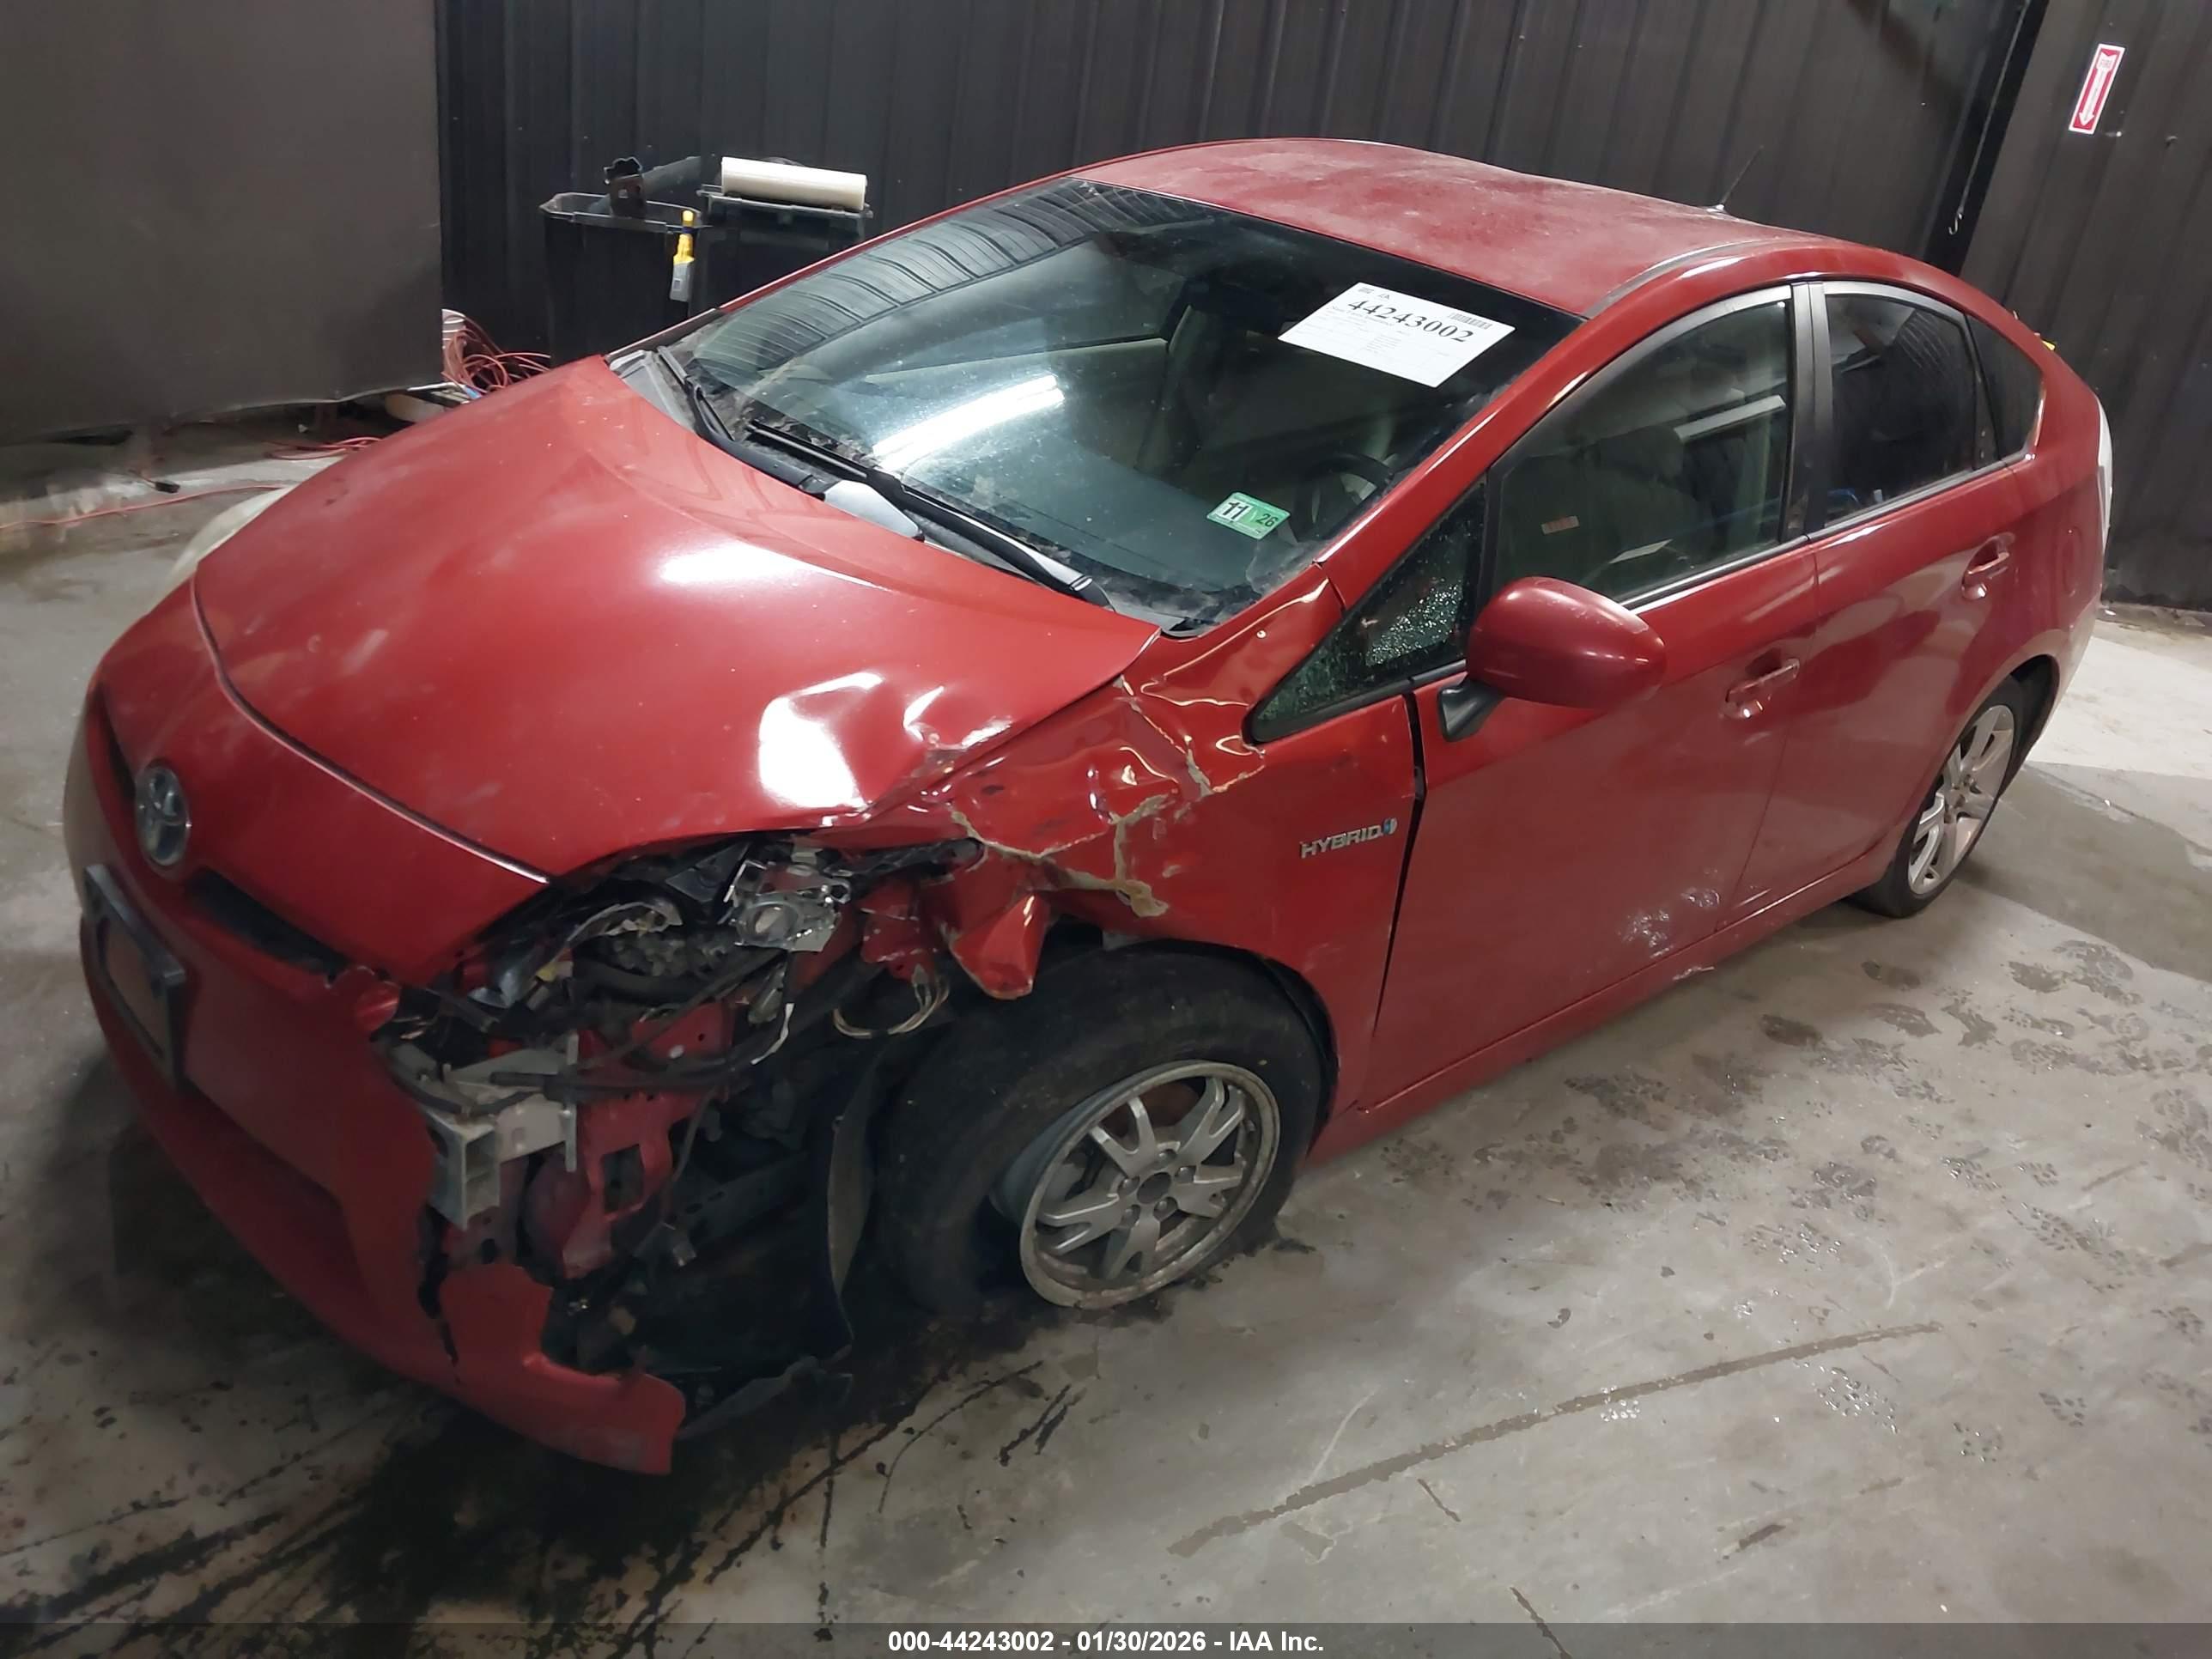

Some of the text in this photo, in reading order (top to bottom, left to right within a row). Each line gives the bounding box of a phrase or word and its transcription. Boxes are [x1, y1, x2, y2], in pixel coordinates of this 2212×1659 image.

[1347, 300, 1474, 343] 44243002
[1222, 501, 1249, 520] 11
[1255, 513, 1279, 527] 26
[1300, 824, 1383, 859] HYBRID
